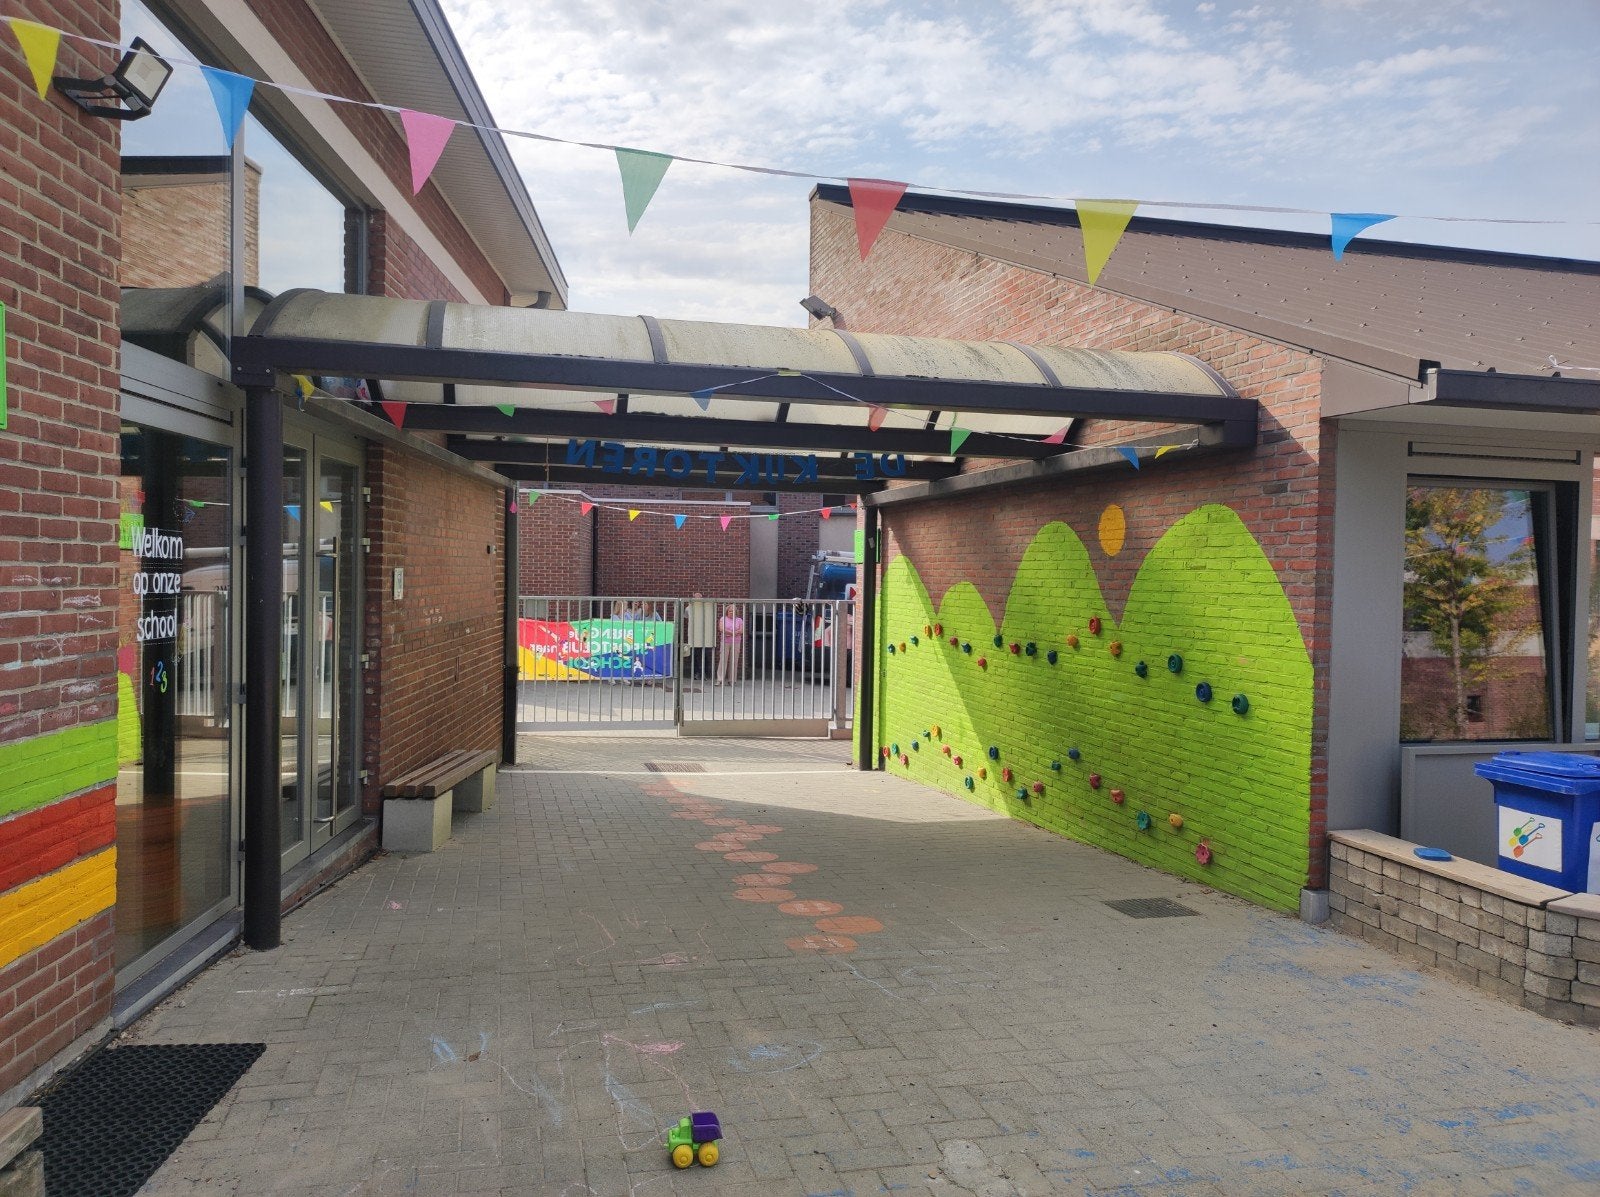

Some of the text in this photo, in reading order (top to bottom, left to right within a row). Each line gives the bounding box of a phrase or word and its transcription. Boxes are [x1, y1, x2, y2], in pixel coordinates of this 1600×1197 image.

[131, 526, 183, 560] Welkom
[133, 572, 181, 595] op onze
[137, 608, 177, 641] school
